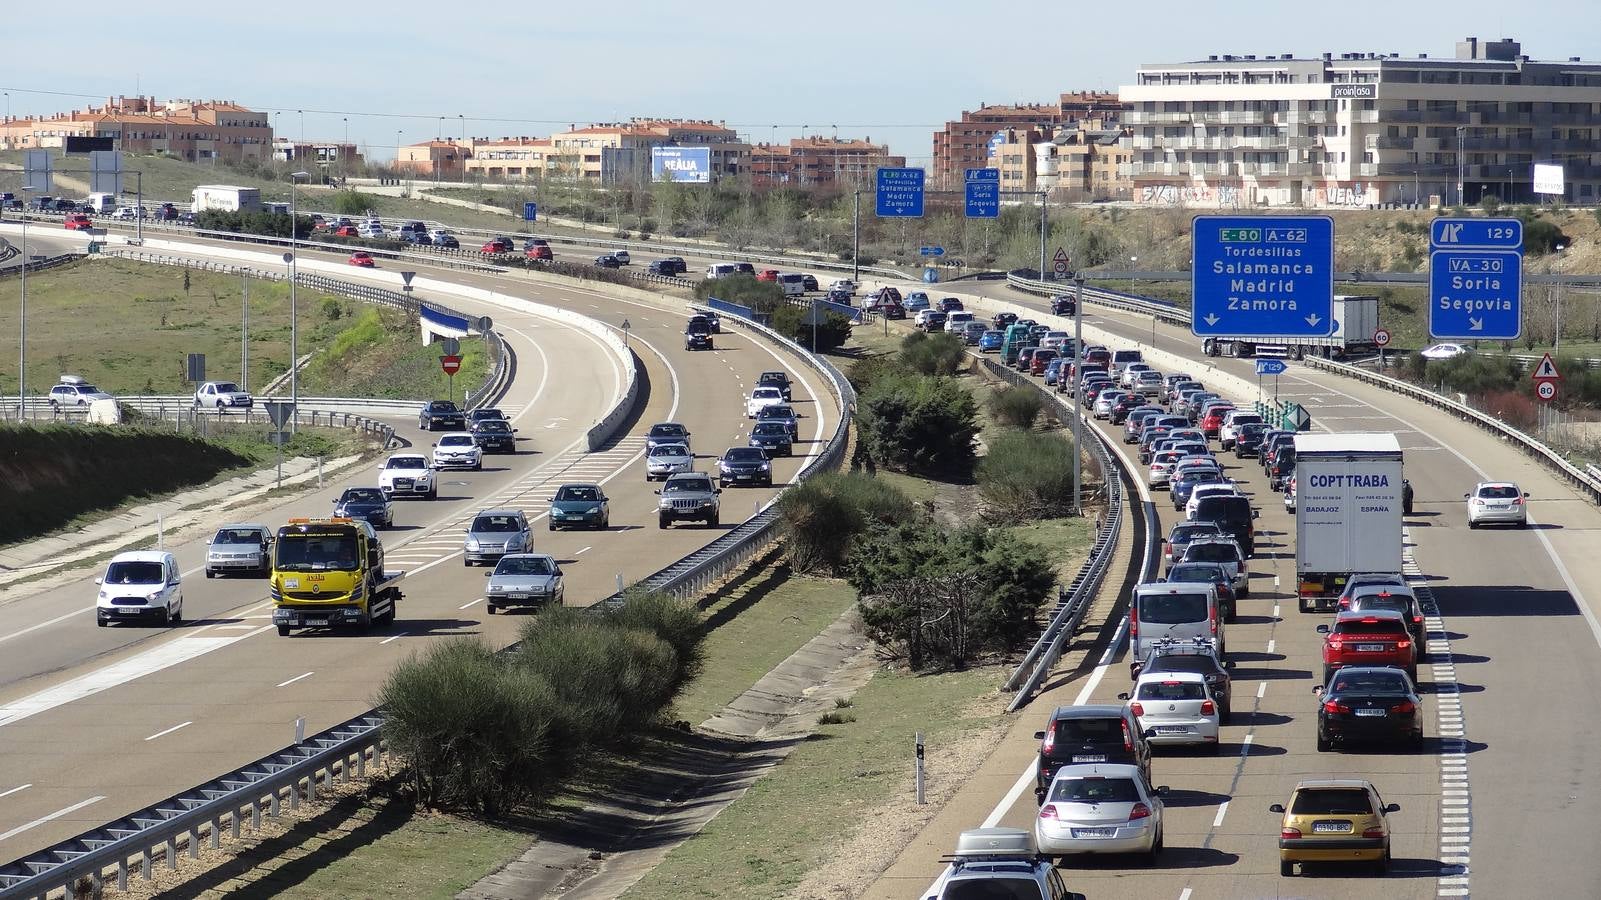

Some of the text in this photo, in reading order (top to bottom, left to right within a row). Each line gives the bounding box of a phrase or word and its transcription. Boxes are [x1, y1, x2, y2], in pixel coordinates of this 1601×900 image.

[973, 191, 991, 199] Soria
[969, 200, 996, 208] Segovia
[1221, 230, 1305, 241] E-80 A-62
[1487, 228, 1514, 239] 129
[1224, 246, 1301, 257] Tordesillas
[1213, 260, 1313, 274] Salamanca
[1451, 260, 1501, 271] VA-30
[1231, 279, 1294, 293] Madrid
[1452, 275, 1500, 290] Soria
[1228, 297, 1297, 311] Zamora
[1440, 296, 1512, 314] Segovia
[1268, 363, 1282, 371] 129
